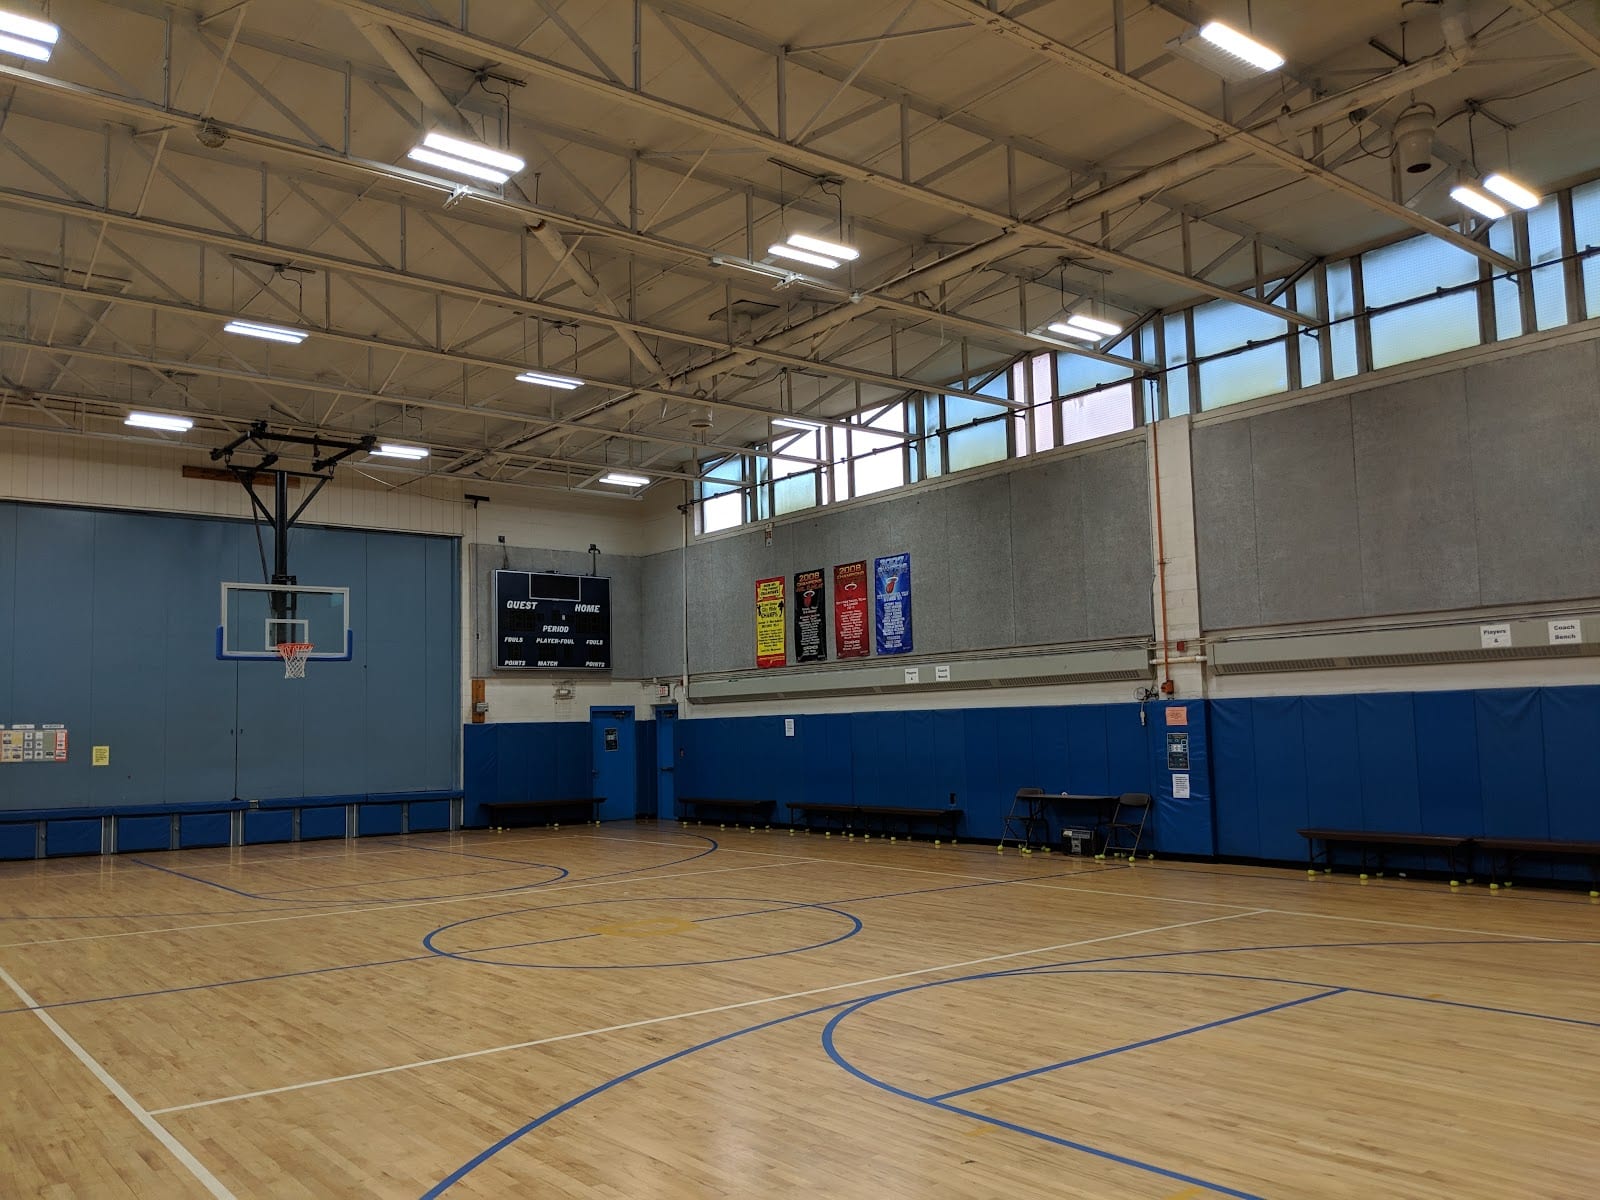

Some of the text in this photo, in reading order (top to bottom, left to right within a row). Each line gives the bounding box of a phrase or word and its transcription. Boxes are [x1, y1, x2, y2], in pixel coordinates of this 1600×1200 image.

[839, 564, 861, 575] 2008
[799, 572, 820, 581] 2008
[507, 600, 538, 610] GUEST
[575, 604, 600, 613] HOME
[542, 625, 569, 633] PERIOD
[536, 637, 575, 645] PLAYER-FOUL
